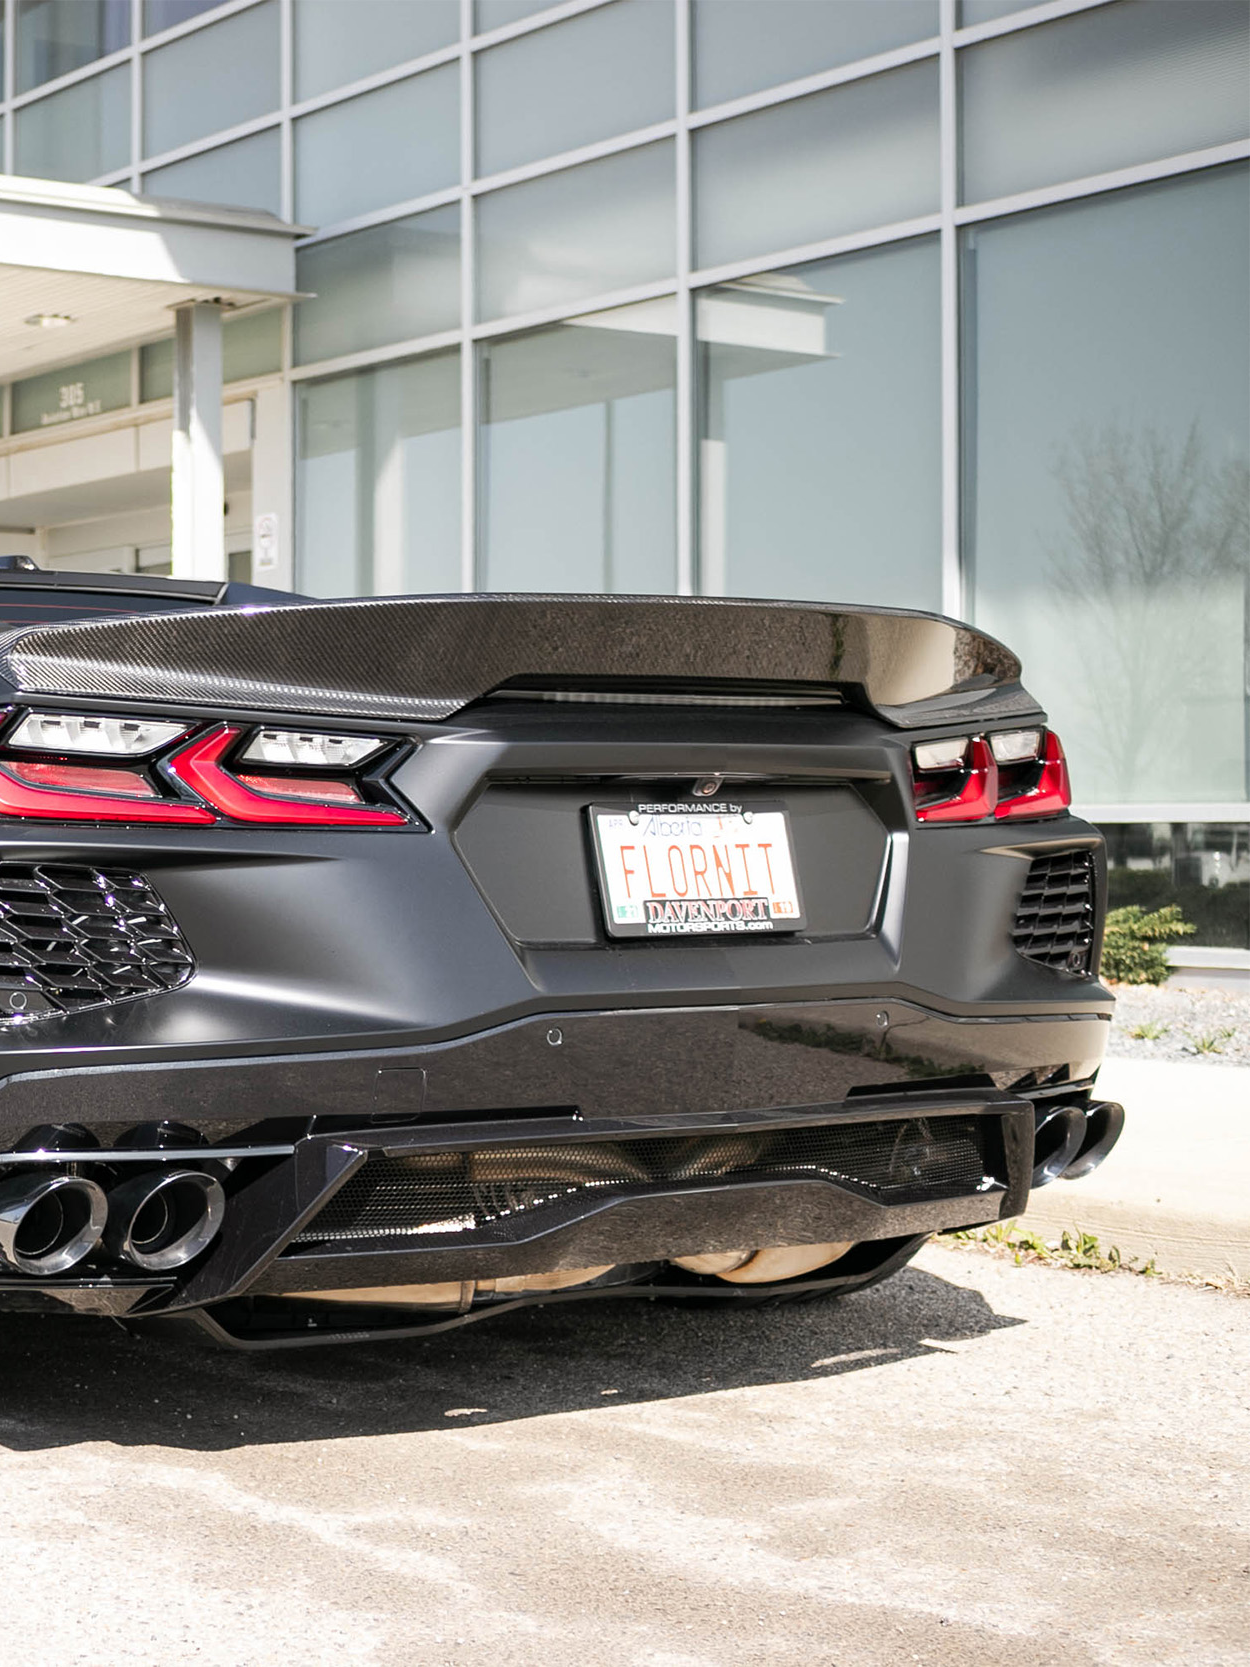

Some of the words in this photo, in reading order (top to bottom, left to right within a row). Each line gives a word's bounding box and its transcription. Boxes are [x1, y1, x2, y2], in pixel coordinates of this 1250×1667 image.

[638, 803, 727, 814] PERFORMANCE
[729, 803, 743, 814] by
[643, 814, 703, 837] Alberta
[620, 843, 775, 899] FLORNIT
[647, 898, 768, 923] DAVENPORT
[648, 921, 774, 934] MOTORSPORTS.com
